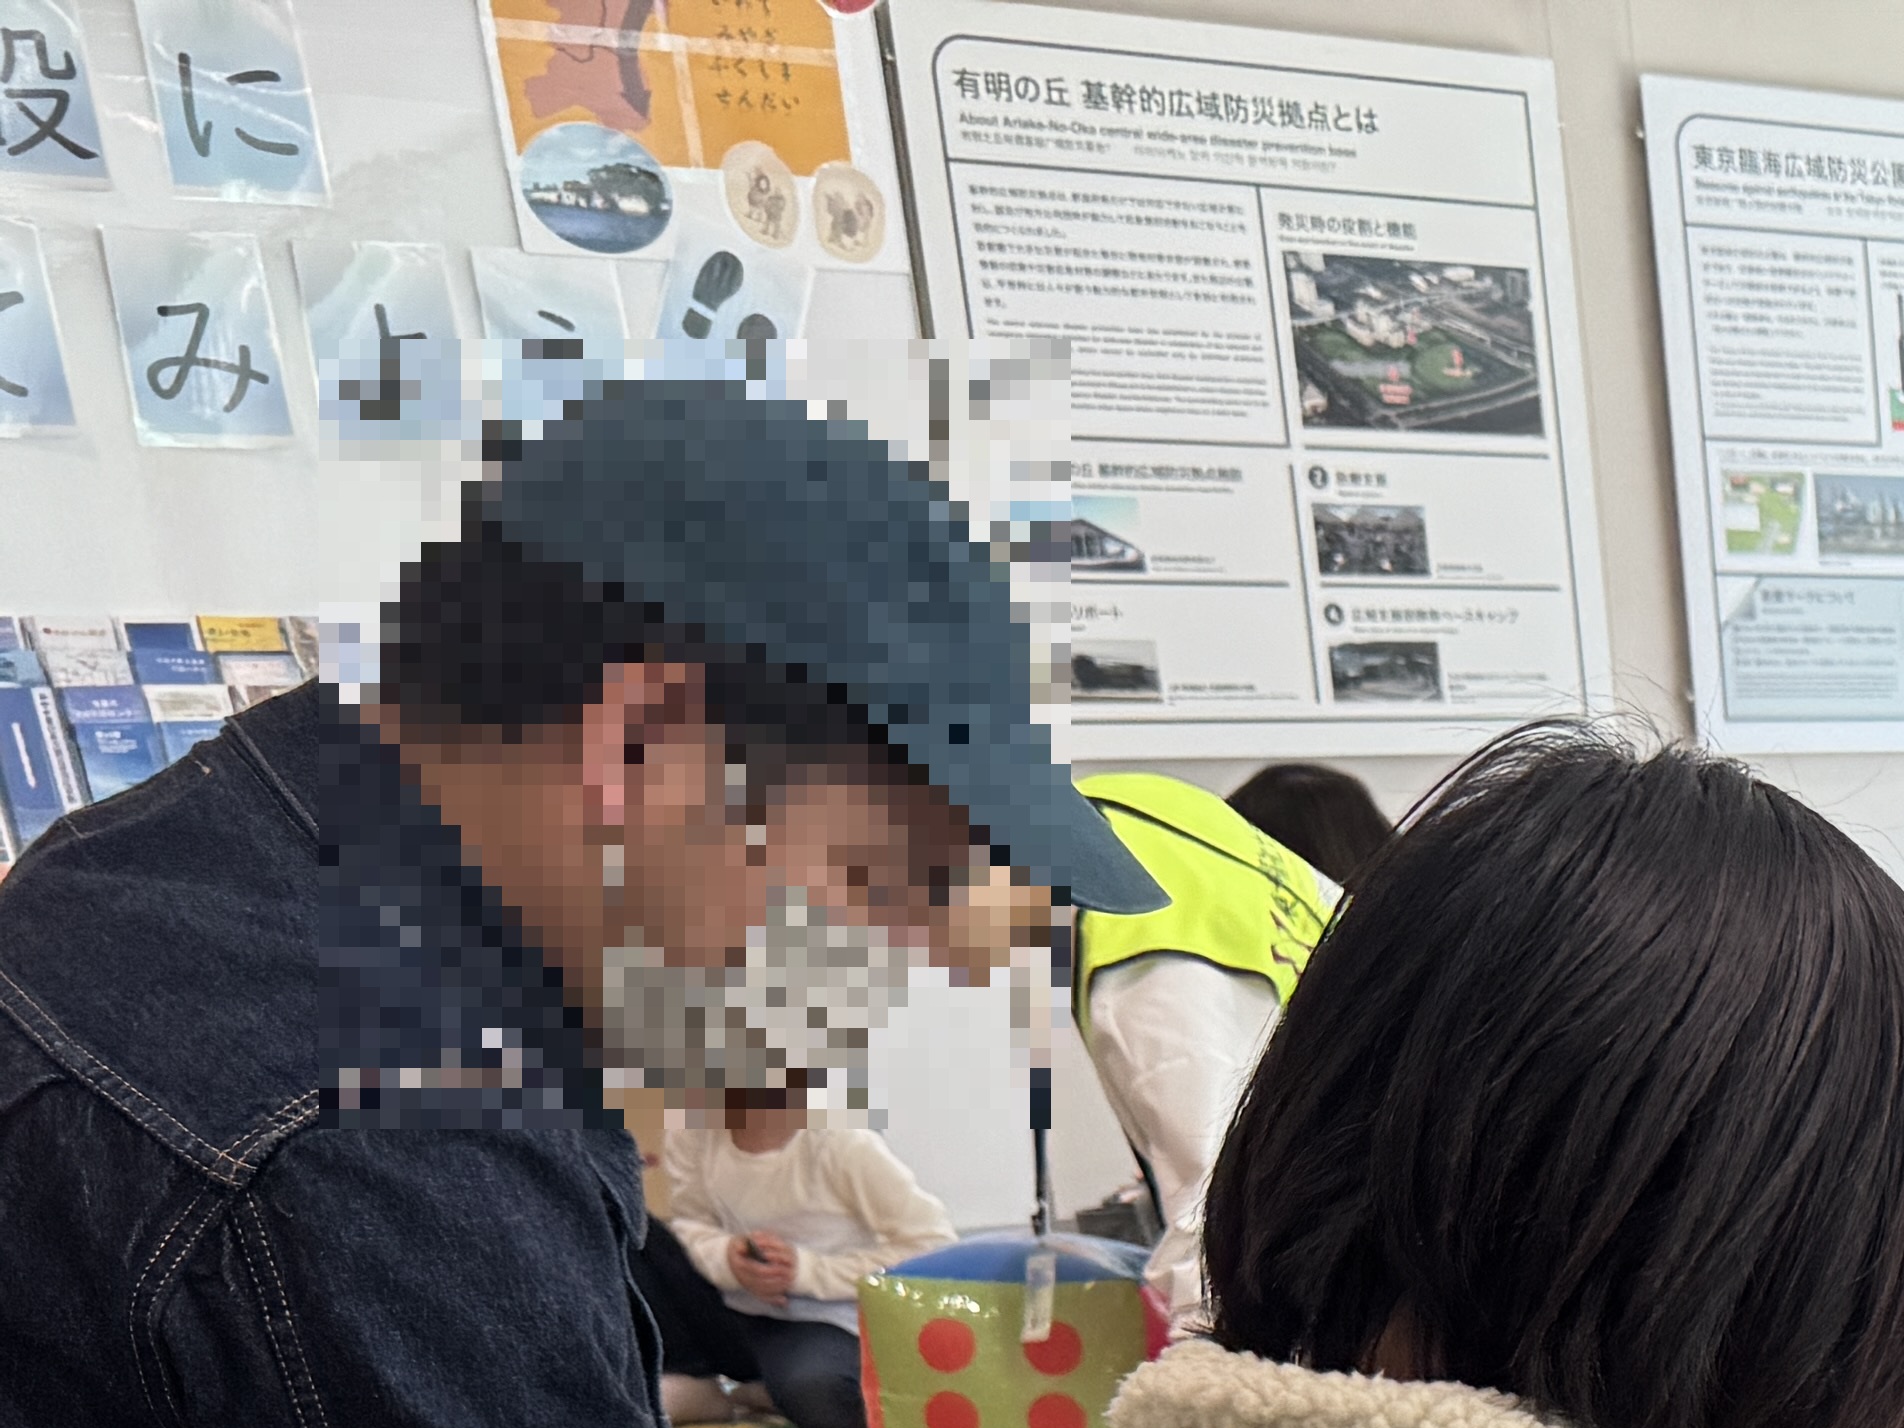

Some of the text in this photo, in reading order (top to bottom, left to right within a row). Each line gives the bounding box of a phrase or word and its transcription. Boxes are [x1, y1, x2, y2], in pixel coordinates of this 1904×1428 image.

[715, 90, 799, 113] せんだい
[952, 68, 1380, 134] 有明の丘 基幹的広域防災拠点とは
